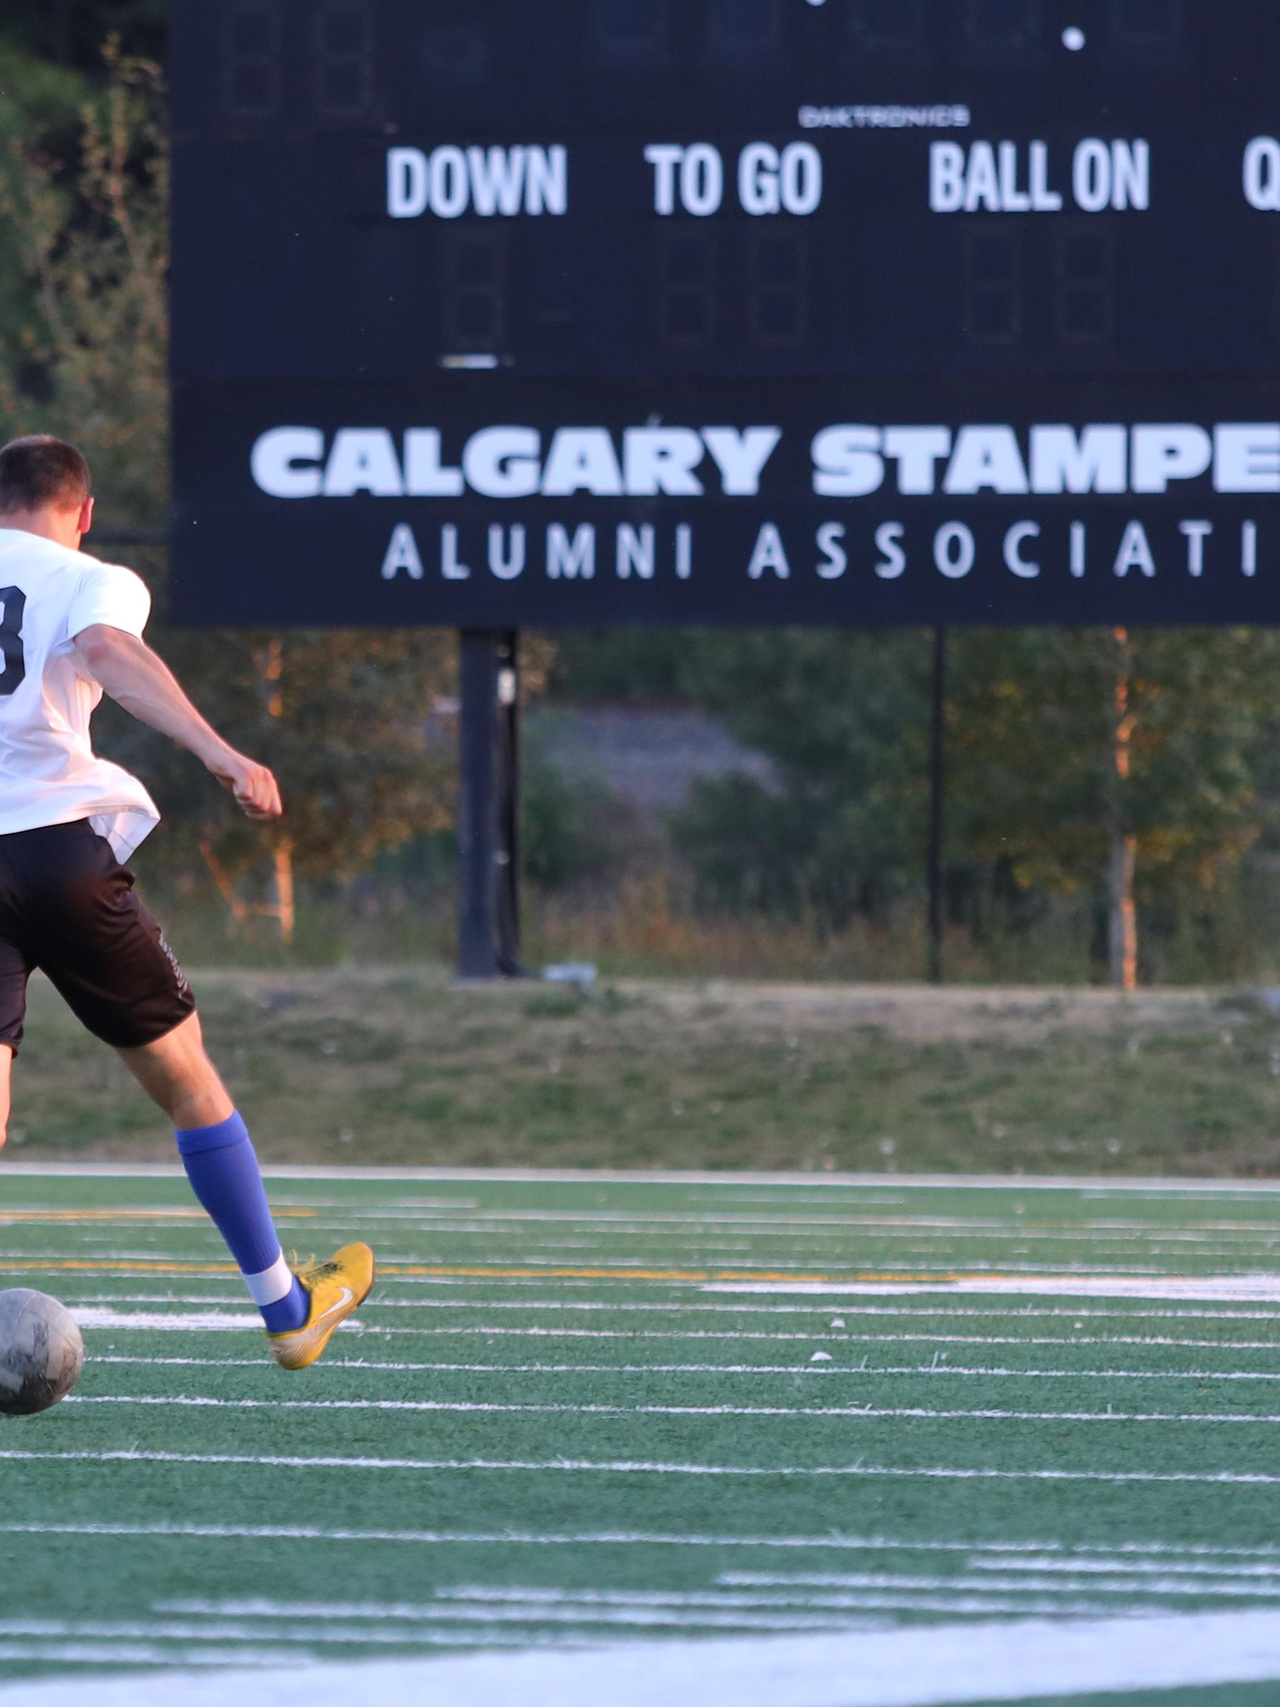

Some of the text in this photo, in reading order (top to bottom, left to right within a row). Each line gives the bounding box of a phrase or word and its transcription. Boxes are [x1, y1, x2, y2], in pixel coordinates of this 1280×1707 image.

[798, 104, 971, 129] DAKTRONICS
[386, 144, 568, 219] DOWN
[643, 141, 822, 217] TO GO
[929, 137, 1150, 213] BALL ON
[250, 422, 1280, 499] CALGARY STAMPE
[380, 519, 1258, 580] ALUMNI ASSOCIATI
